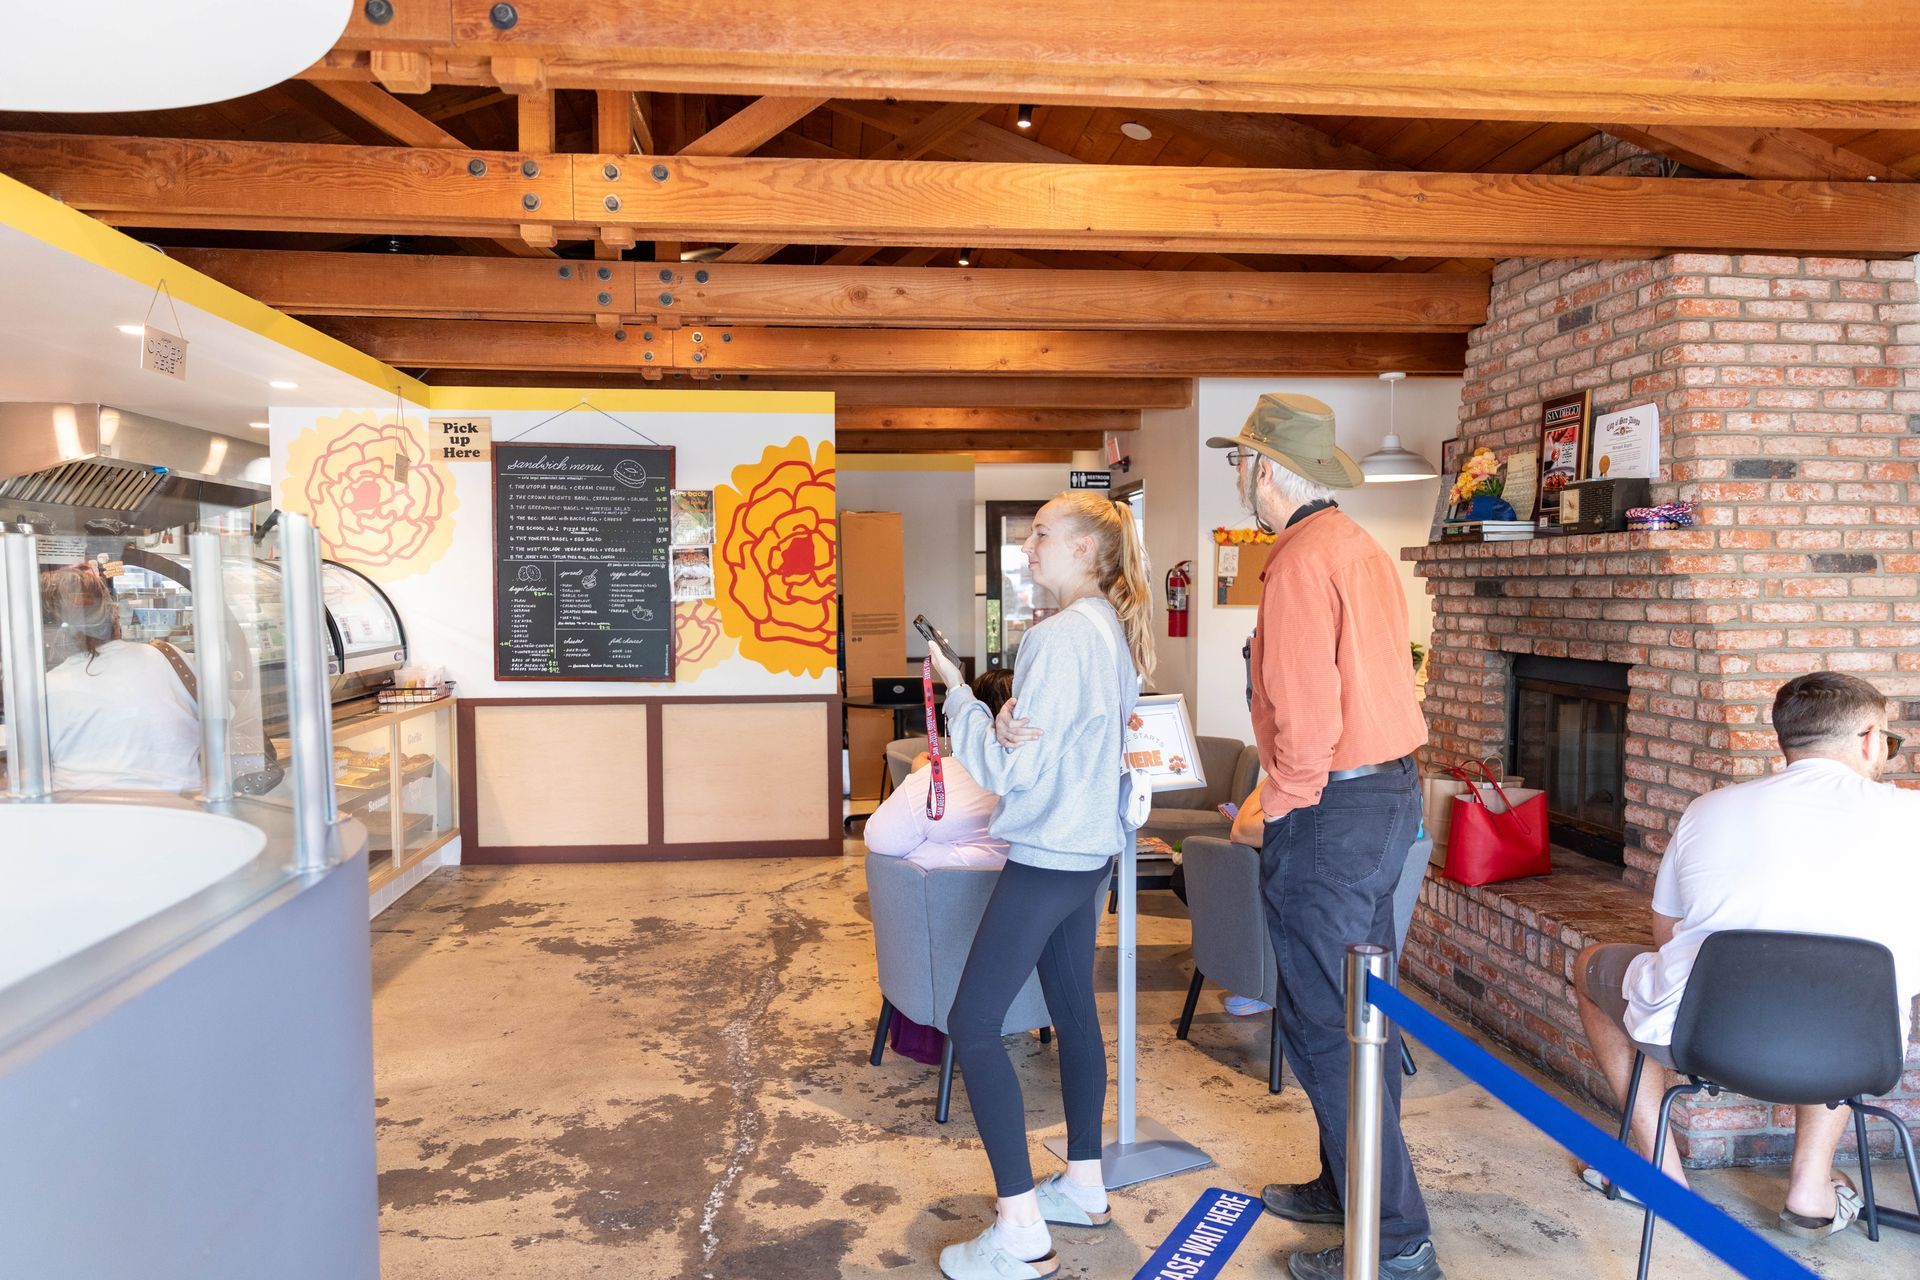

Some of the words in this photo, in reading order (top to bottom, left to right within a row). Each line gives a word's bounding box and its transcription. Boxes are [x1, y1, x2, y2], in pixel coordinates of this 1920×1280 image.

[148, 338, 183, 364] ORDER
[154, 359, 175, 374] HERE
[1547, 410, 1561, 422] SAN
[1560, 405, 1580, 419] DIEGO
[443, 422, 479, 434] Pick
[450, 436, 471, 447] up
[443, 447, 481, 458] Here
[507, 454, 570, 471] sandwich
[569, 464, 604, 472] menu
[610, 571, 627, 581] veggie
[509, 585, 527, 595] bagel
[1133, 733, 1165, 748] STARTS
[1123, 750, 1164, 769] HERE
[935, 782, 944, 793] STATE
[368, 795, 389, 813] Sesame
[1178, 1222, 1228, 1257] WAIT
[1203, 1193, 1251, 1226] HERE
